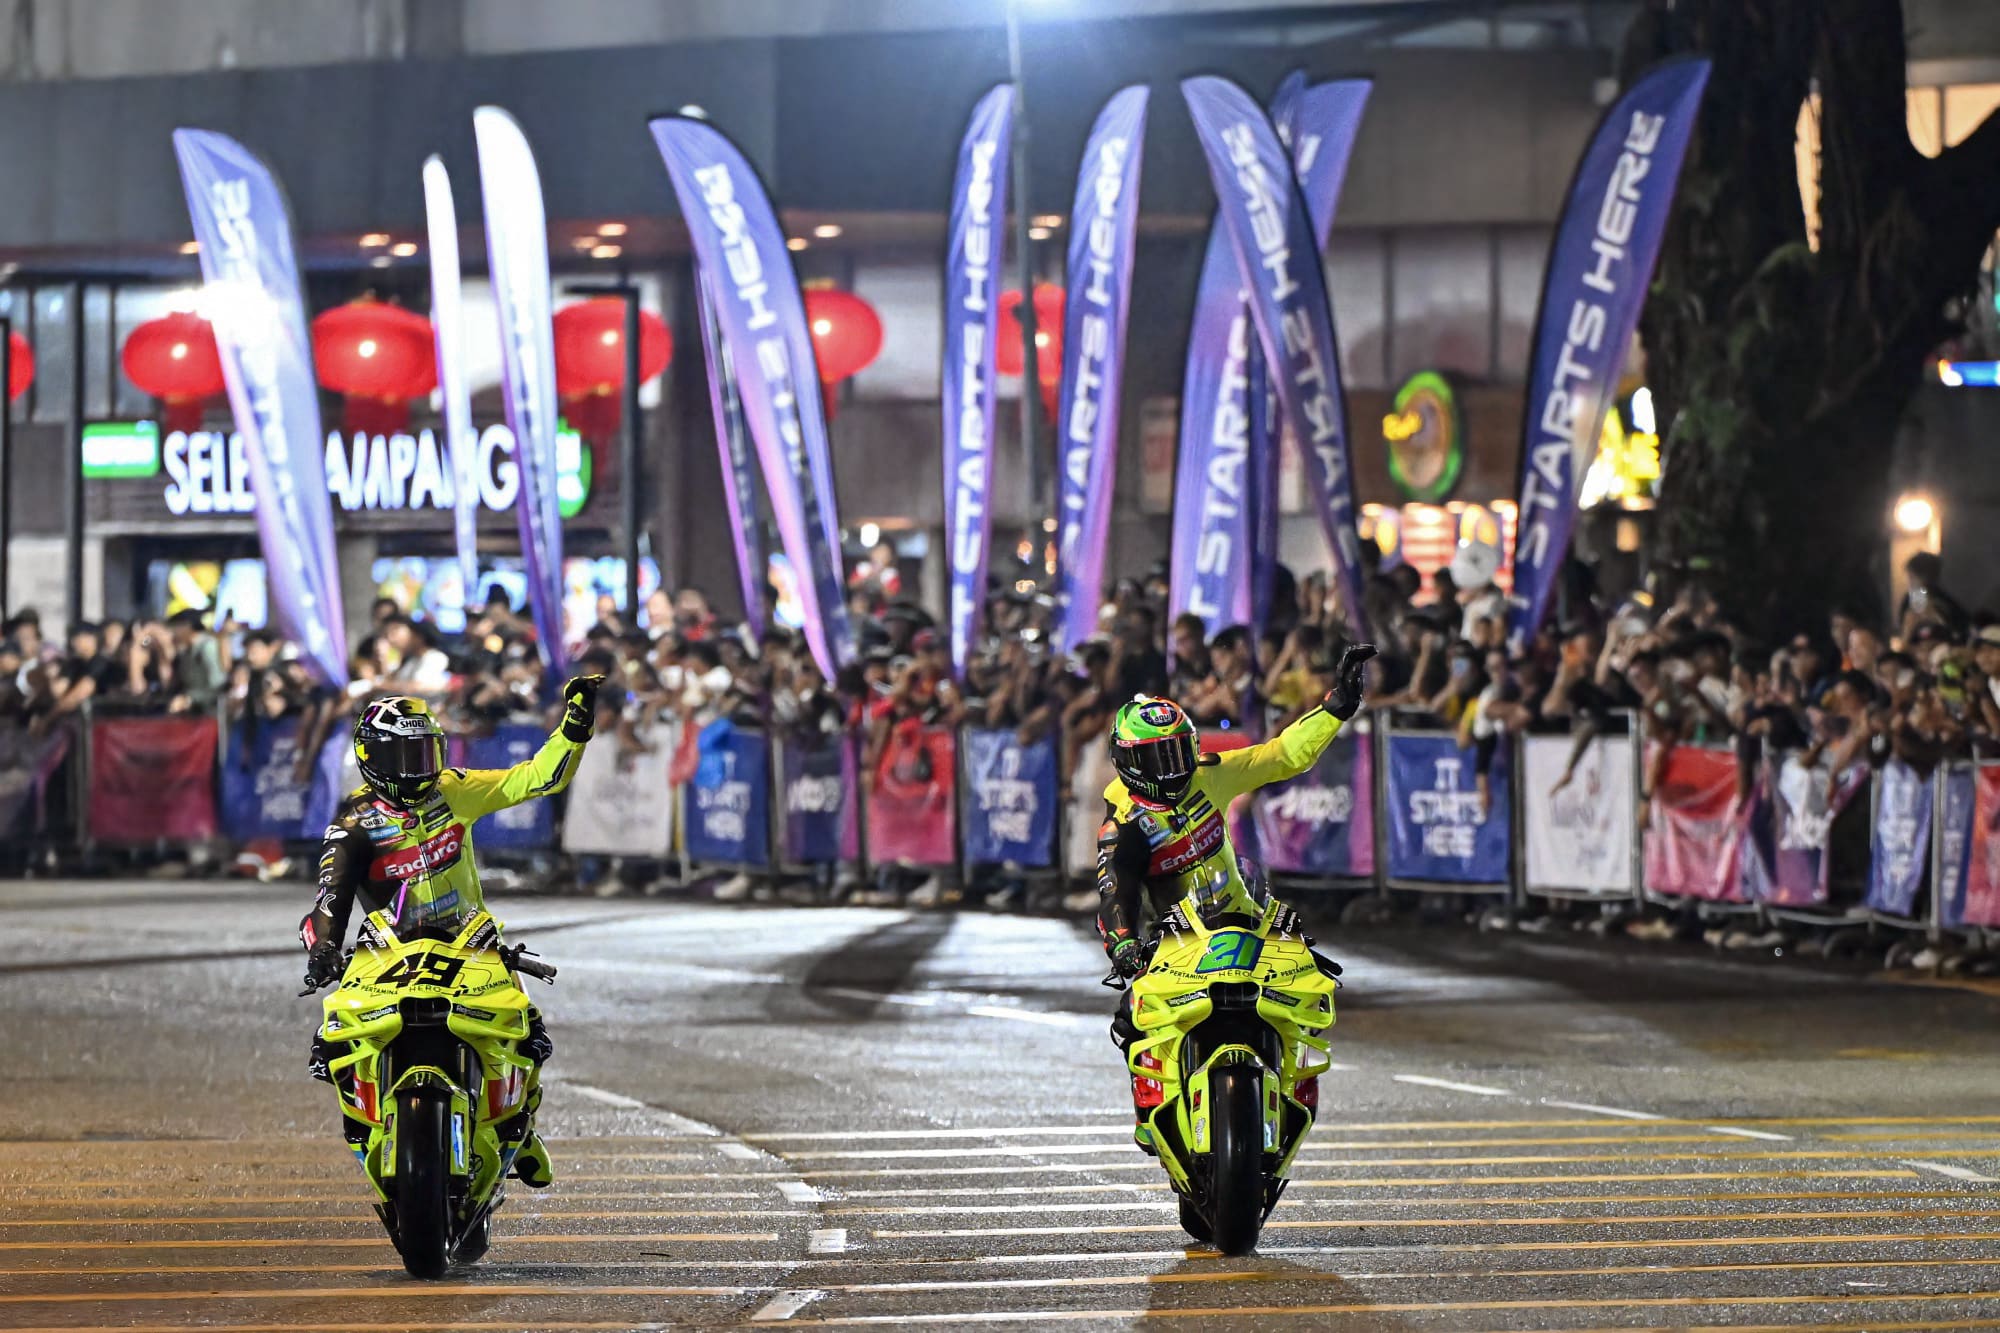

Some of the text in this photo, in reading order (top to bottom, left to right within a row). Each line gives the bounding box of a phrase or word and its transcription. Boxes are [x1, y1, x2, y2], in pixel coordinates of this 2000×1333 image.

[1515, 110, 1665, 569] STARTS HERE
[1058, 314, 1108, 578] ARTS
[384, 840, 460, 879] Enduro
[1160, 825, 1222, 871] Enduro
[374, 951, 466, 989] 49
[1202, 932, 1259, 970] 21
[1280, 962, 1316, 978] PERTAMINA
[360, 985, 399, 996] PERTAMINA
[472, 979, 511, 993] PERTAMINA
[1169, 969, 1208, 981] PERTAMINA
